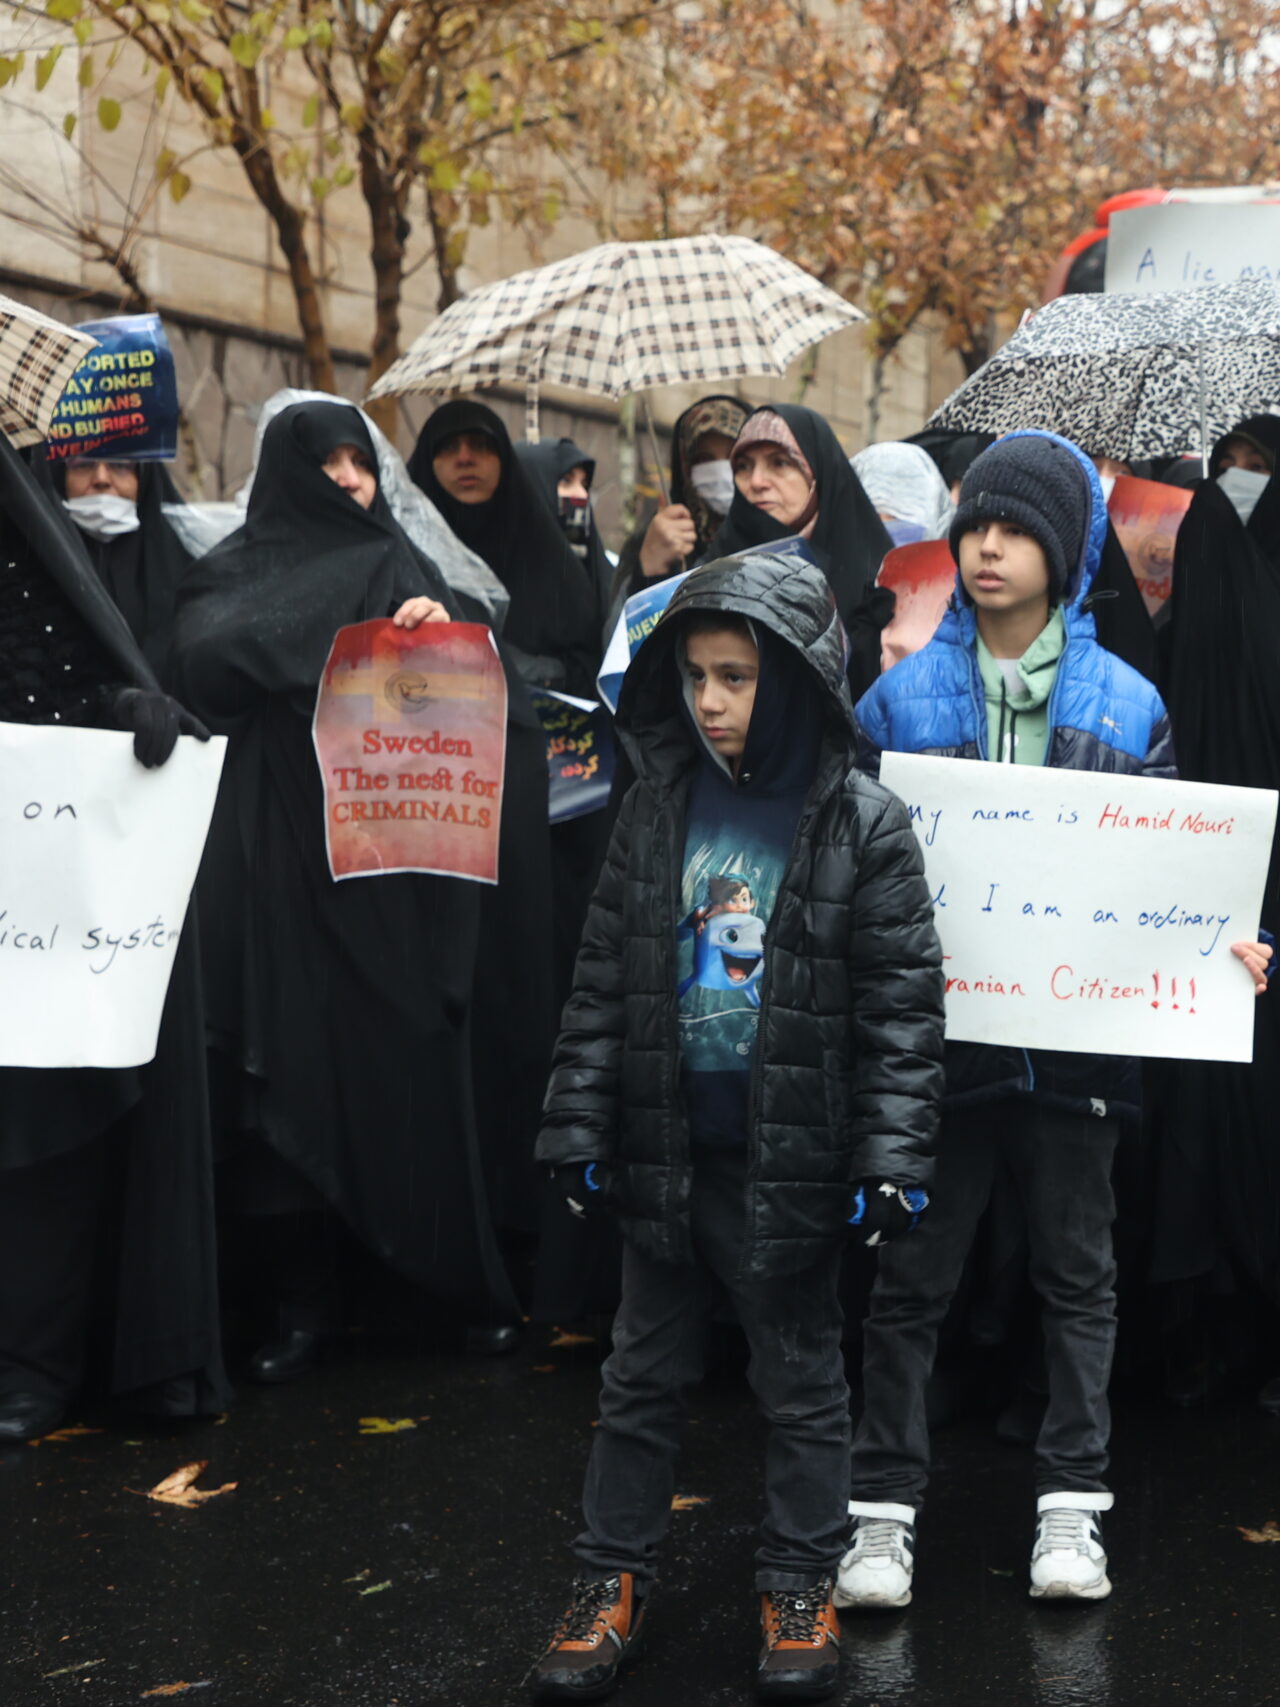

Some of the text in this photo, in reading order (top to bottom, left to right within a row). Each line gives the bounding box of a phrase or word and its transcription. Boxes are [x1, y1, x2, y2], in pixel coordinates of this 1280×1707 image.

[1136, 248, 1157, 282] A
[1183, 250, 1216, 282] lie
[100, 371, 153, 391] ONCE
[60, 393, 142, 417] HUMANS
[75, 412, 145, 437] BURIED
[362, 729, 473, 757] Sweden
[333, 767, 499, 799] The nest for
[332, 800, 492, 829] CRIMINALS
[972, 807, 1035, 822] name
[1057, 804, 1079, 824] is
[1098, 801, 1176, 831] Hamid
[1179, 813, 1237, 836] Nouri
[0, 911, 60, 951] ical
[981, 883, 1230, 957] I am an ordinary
